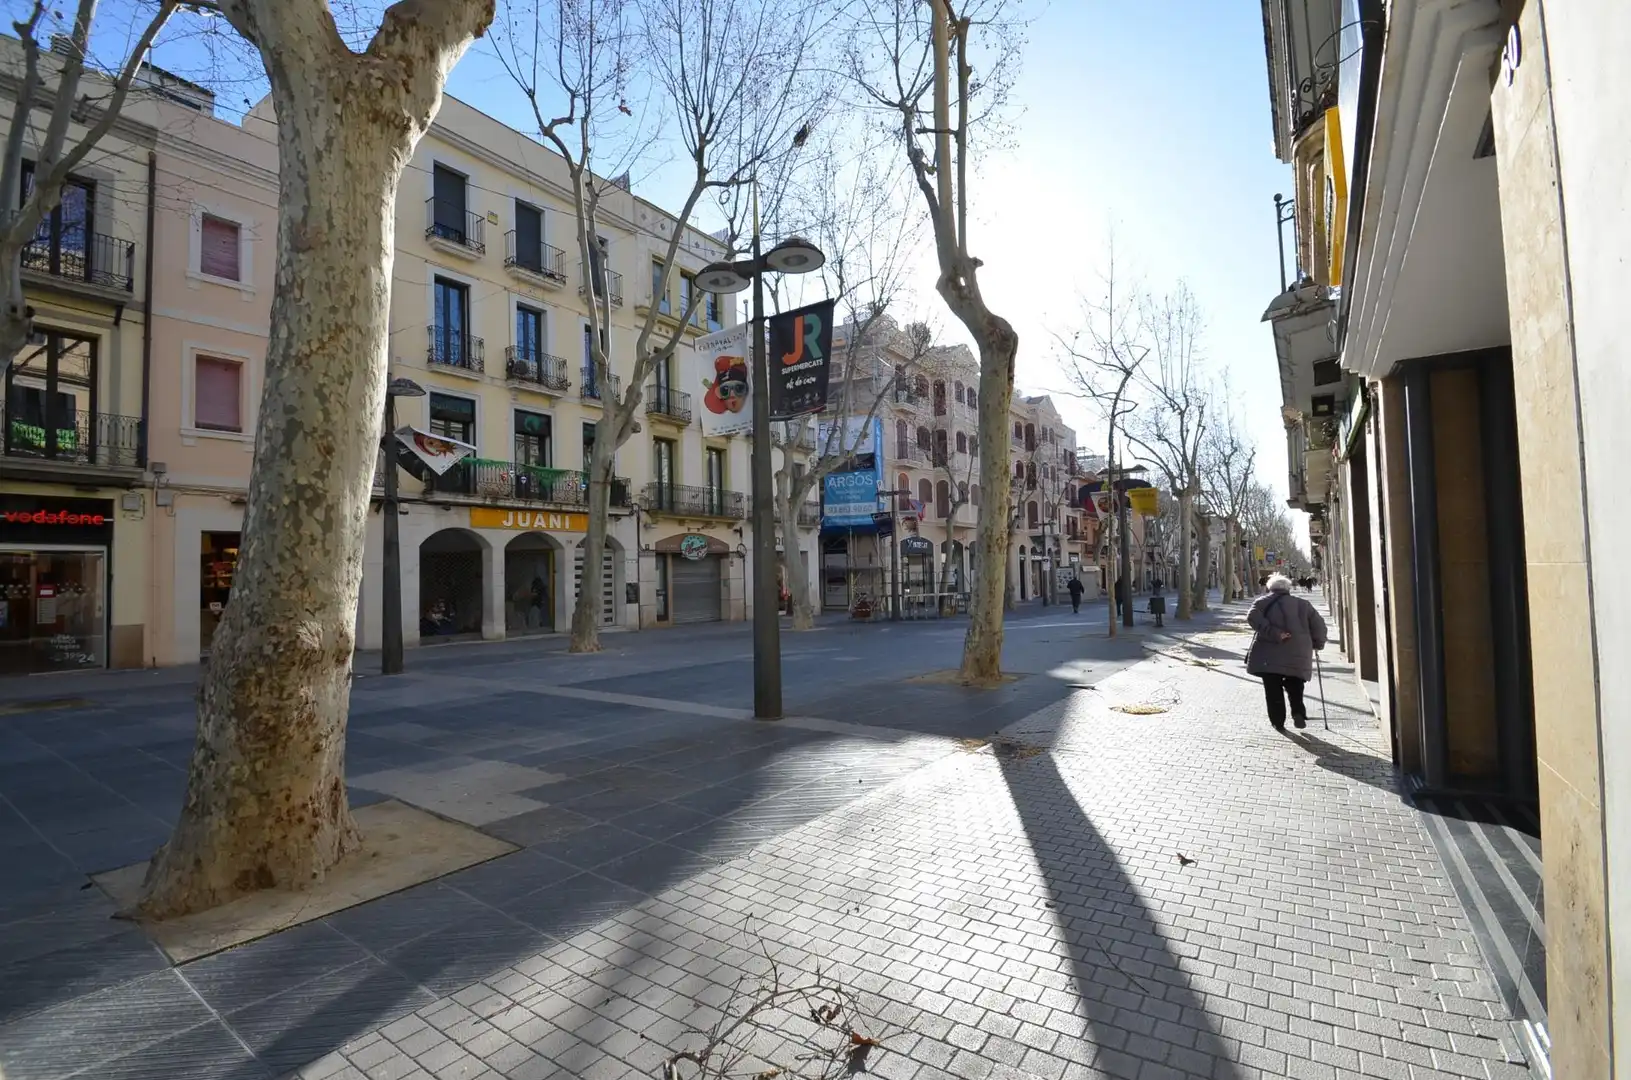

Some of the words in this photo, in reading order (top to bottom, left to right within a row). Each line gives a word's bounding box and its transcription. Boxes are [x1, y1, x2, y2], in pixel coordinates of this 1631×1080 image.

[783, 313, 823, 365] JR
[781, 358, 824, 375] SUPERMERCATS
[828, 474, 873, 489] ARGOS
[5, 509, 104, 525] vodafone
[502, 511, 570, 529] JUANI
